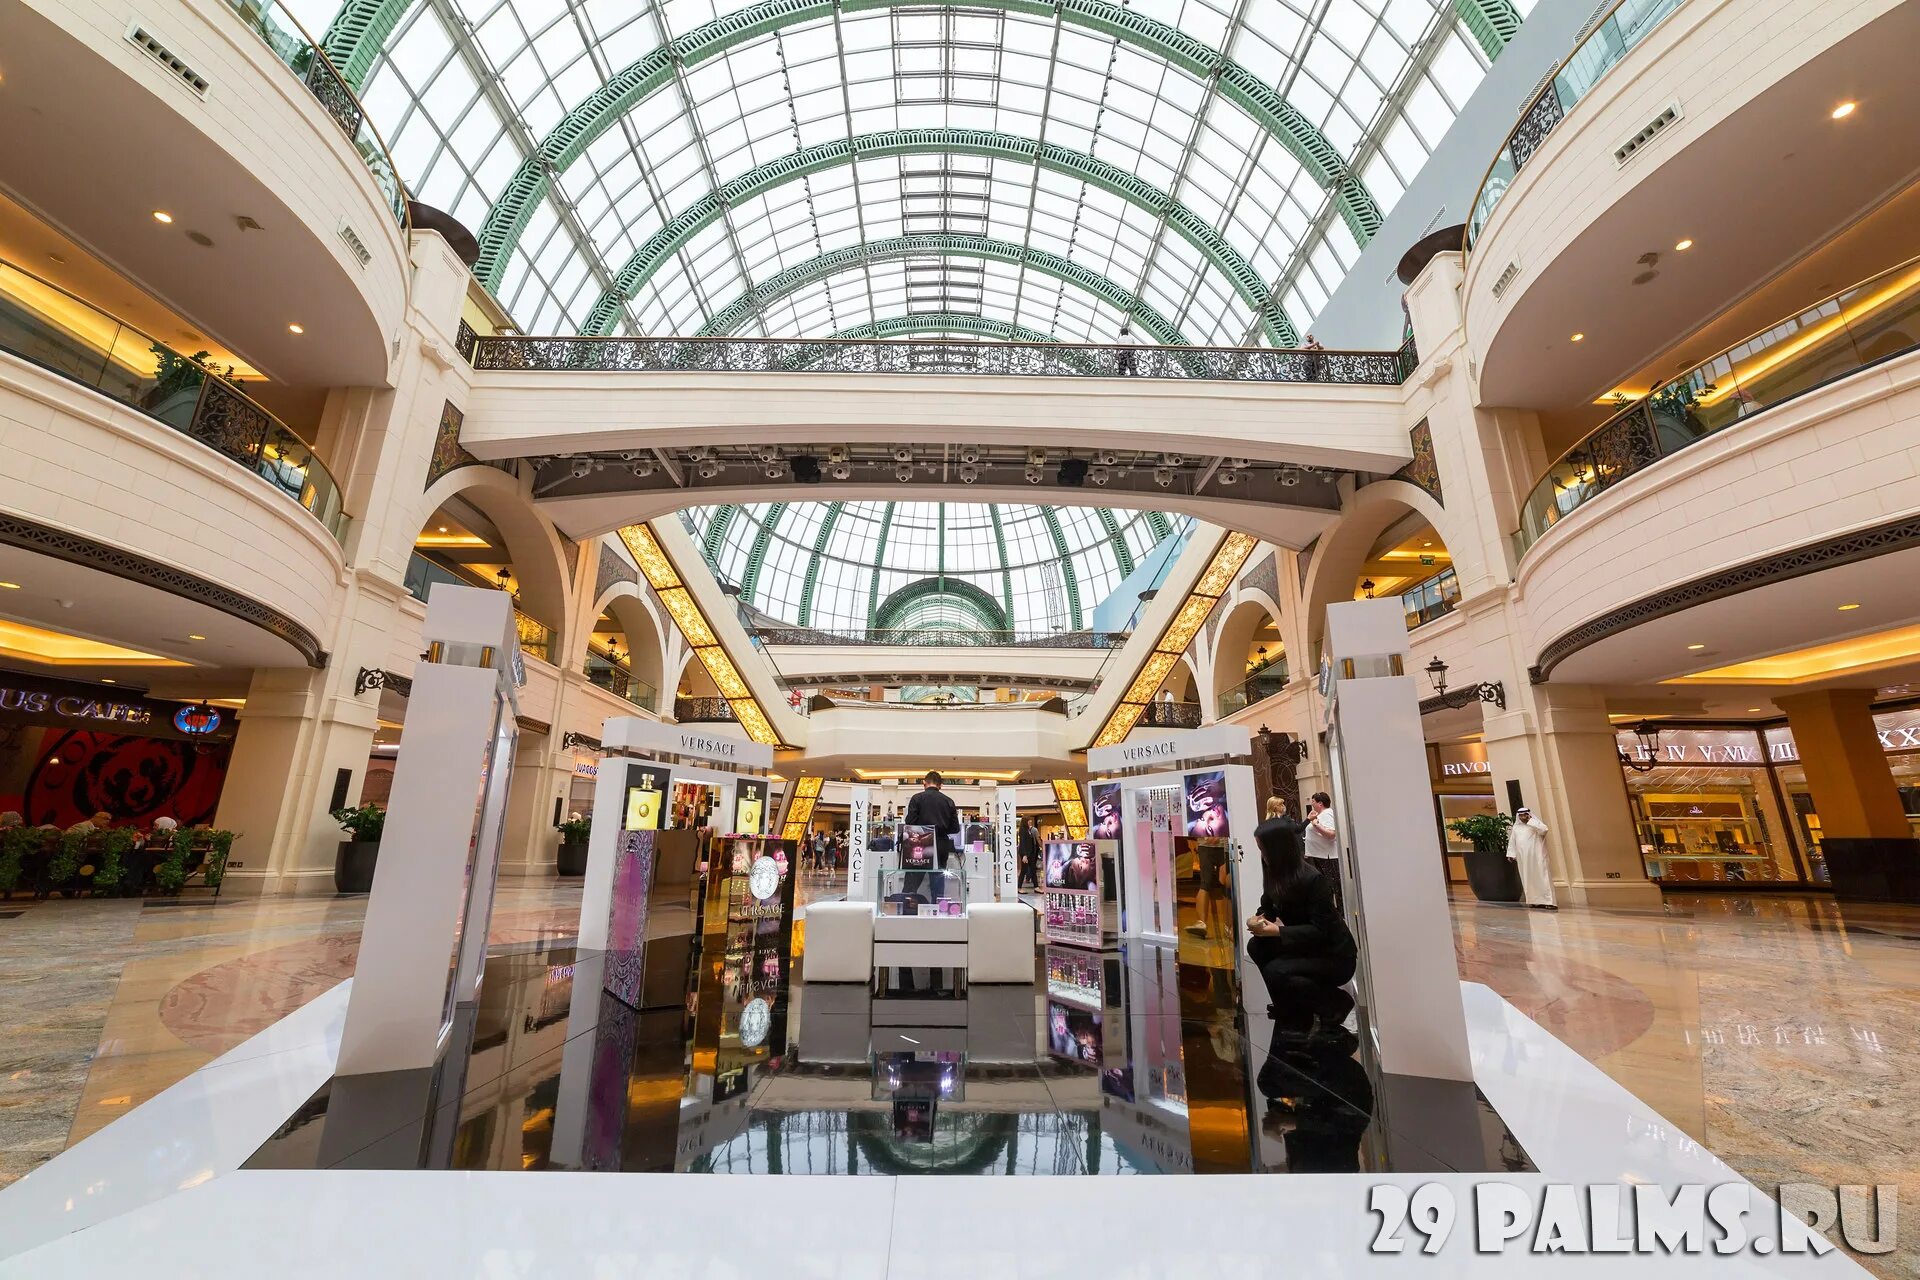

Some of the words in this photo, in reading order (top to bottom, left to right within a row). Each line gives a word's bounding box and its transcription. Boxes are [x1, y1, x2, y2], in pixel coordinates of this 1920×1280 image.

[681, 735, 736, 756] VERSACE
[1123, 741, 1176, 760] VERSACE
[1666, 745, 1686, 760] IV
[1697, 745, 1713, 761] V
[852, 800, 863, 882] VERSACE
[1003, 801, 1013, 884] VERSACE
